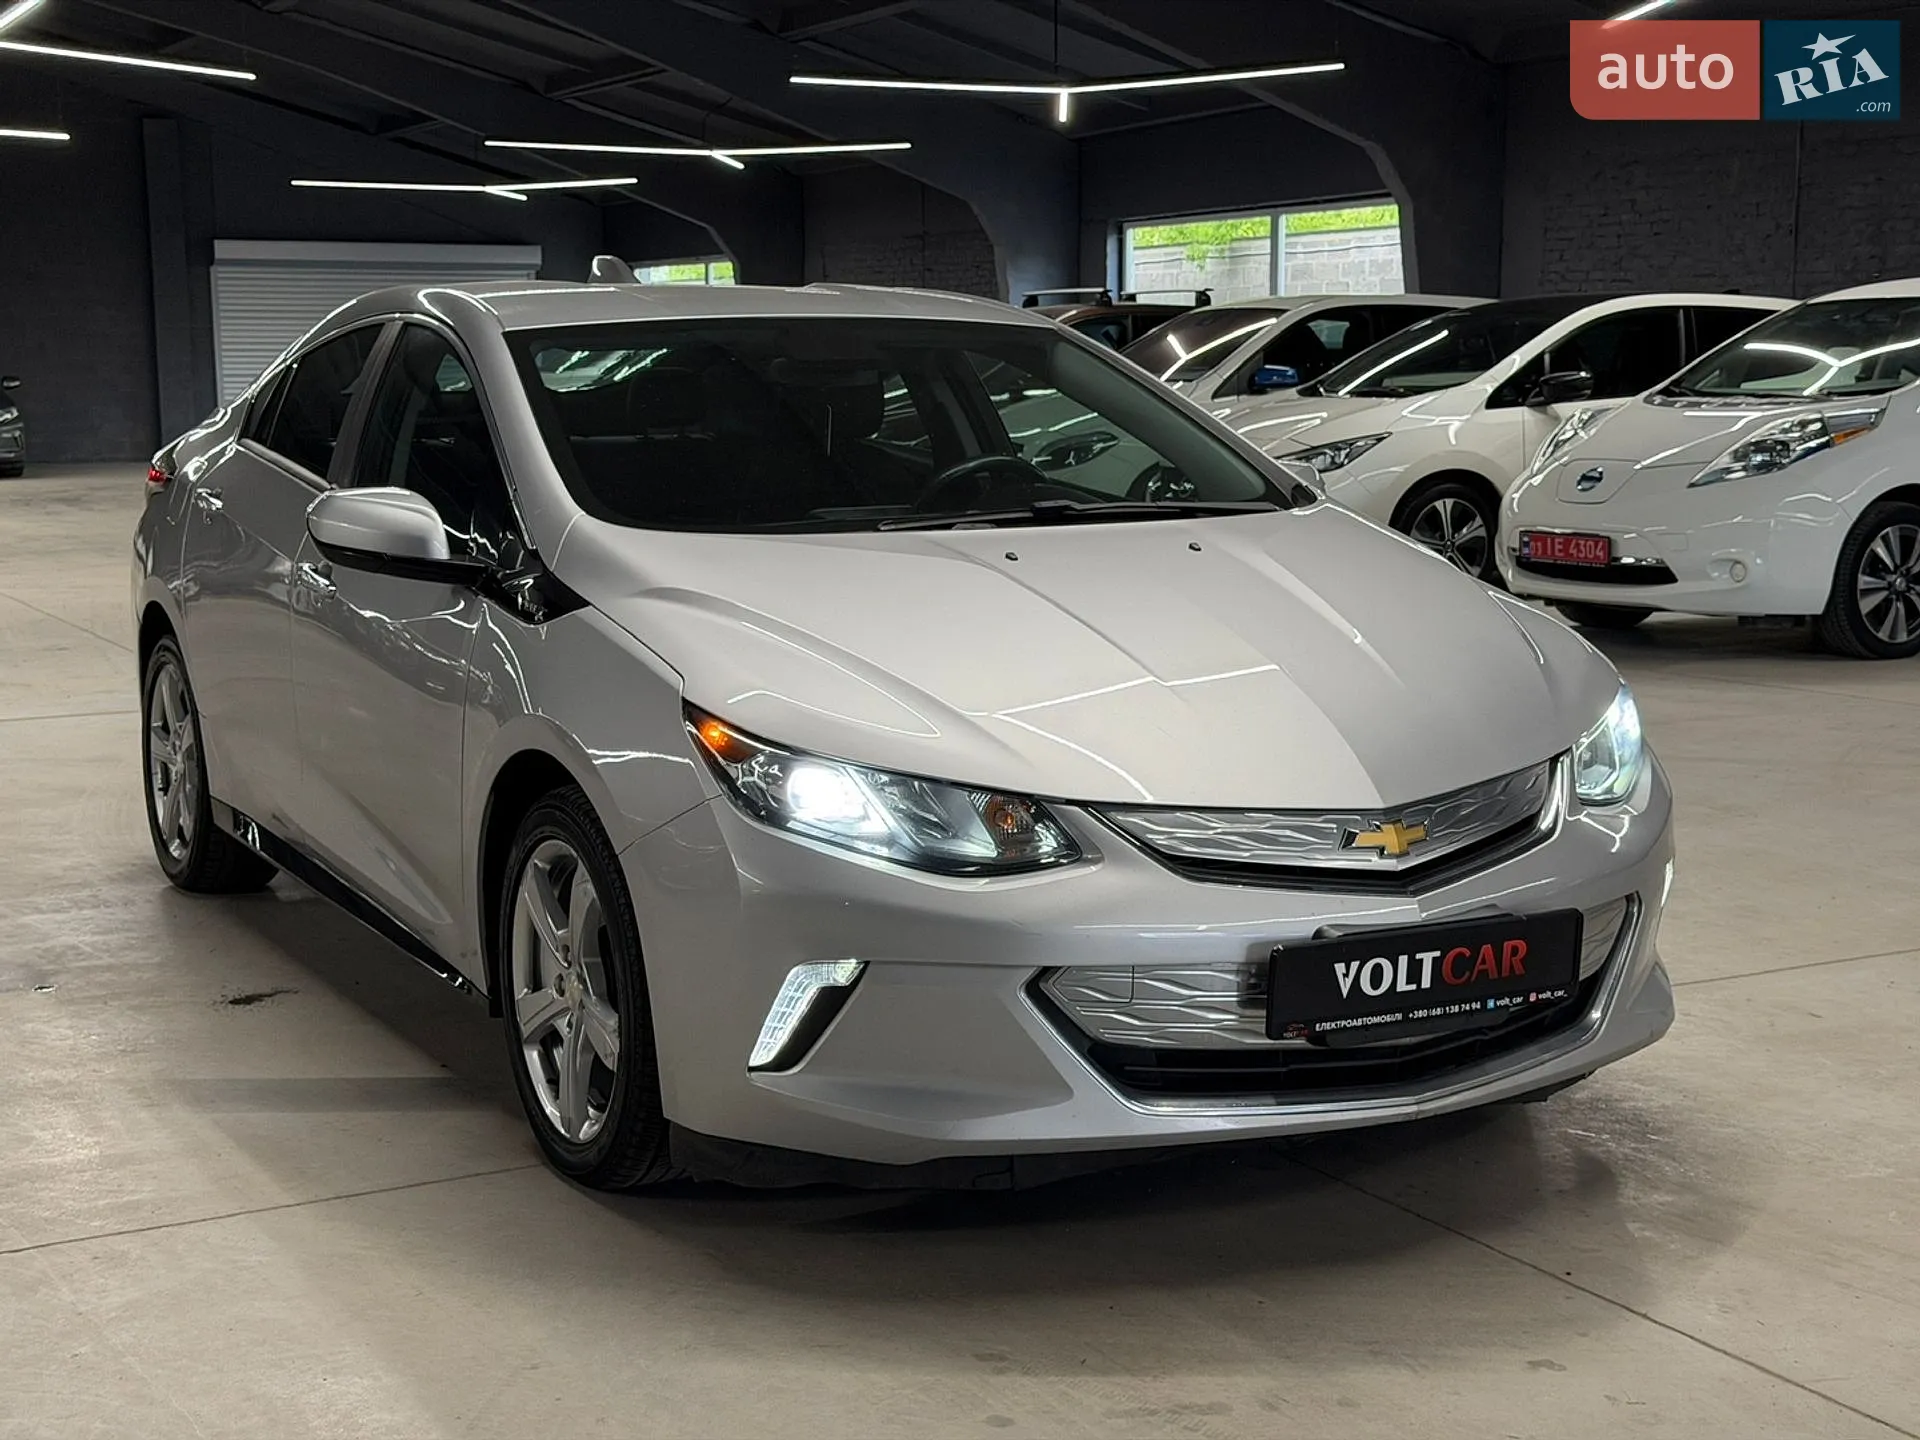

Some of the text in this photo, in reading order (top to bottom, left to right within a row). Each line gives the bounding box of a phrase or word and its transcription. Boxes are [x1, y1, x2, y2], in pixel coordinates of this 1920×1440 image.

[1547, 537, 1564, 556] IE
[1569, 539, 1603, 560] 4304
[1334, 939, 1527, 999] VOLTCAR
[1496, 995, 1524, 1007] volt_car
[1315, 1012, 1403, 1032] ЕЛЕКТРОАВТОМОБІЛІ
[1408, 1009, 1428, 1019] +380
[1460, 1003, 1470, 1012] 74
[1471, 1001, 1481, 1010] 94
